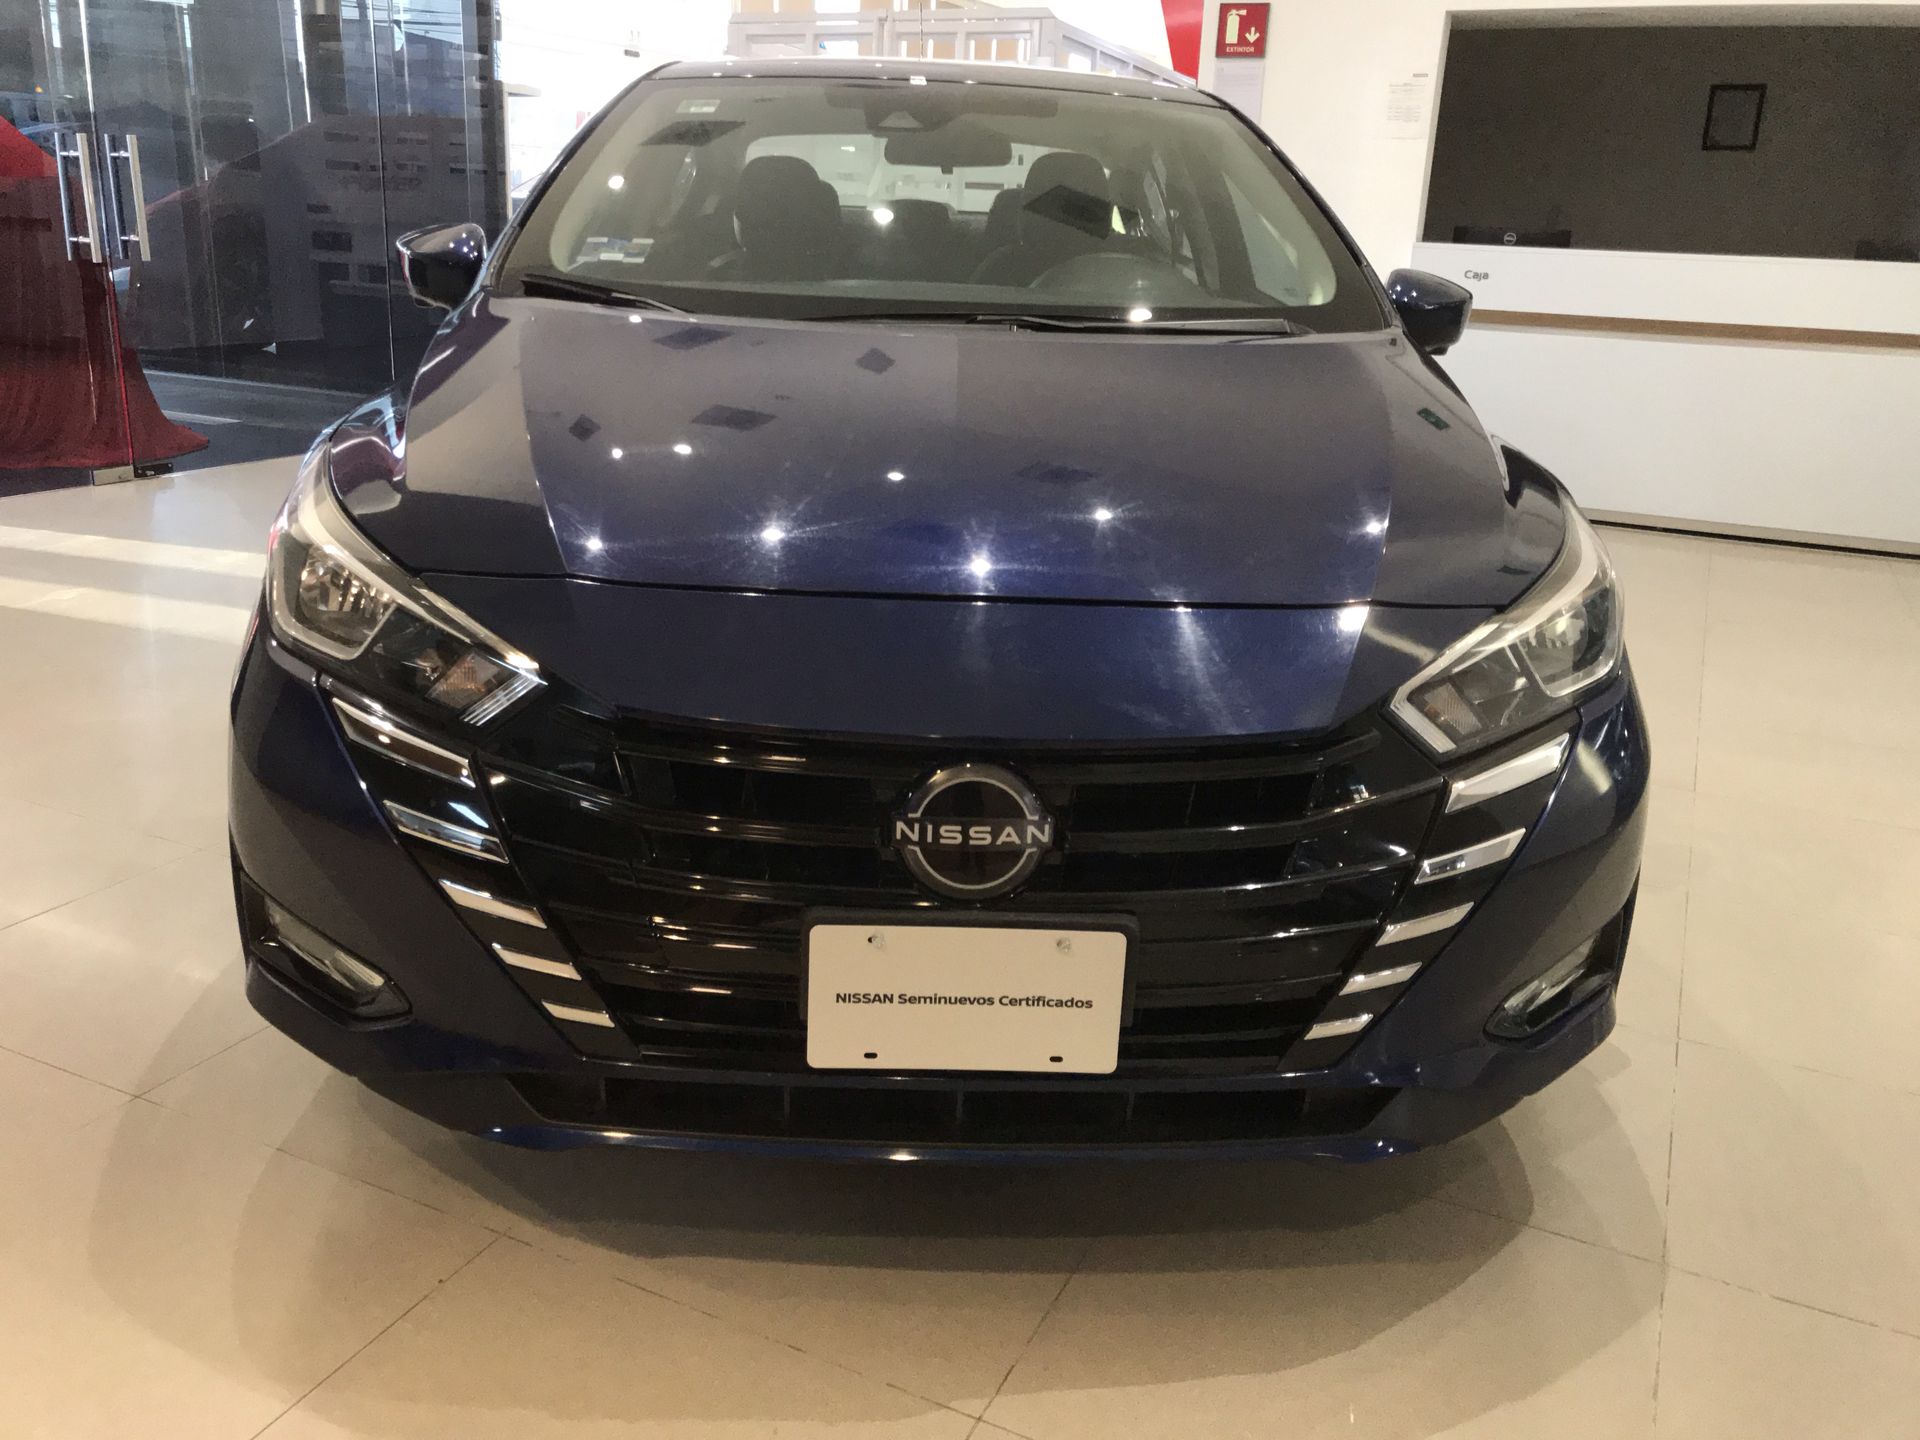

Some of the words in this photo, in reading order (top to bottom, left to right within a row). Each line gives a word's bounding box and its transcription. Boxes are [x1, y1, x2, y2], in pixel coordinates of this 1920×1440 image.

[1464, 269, 1489, 282] Caja
[895, 820, 1050, 846] NISSAN
[835, 993, 894, 1005] NISSAN
[898, 993, 995, 1006] Seminuevos
[998, 995, 1093, 1009] Certificados
